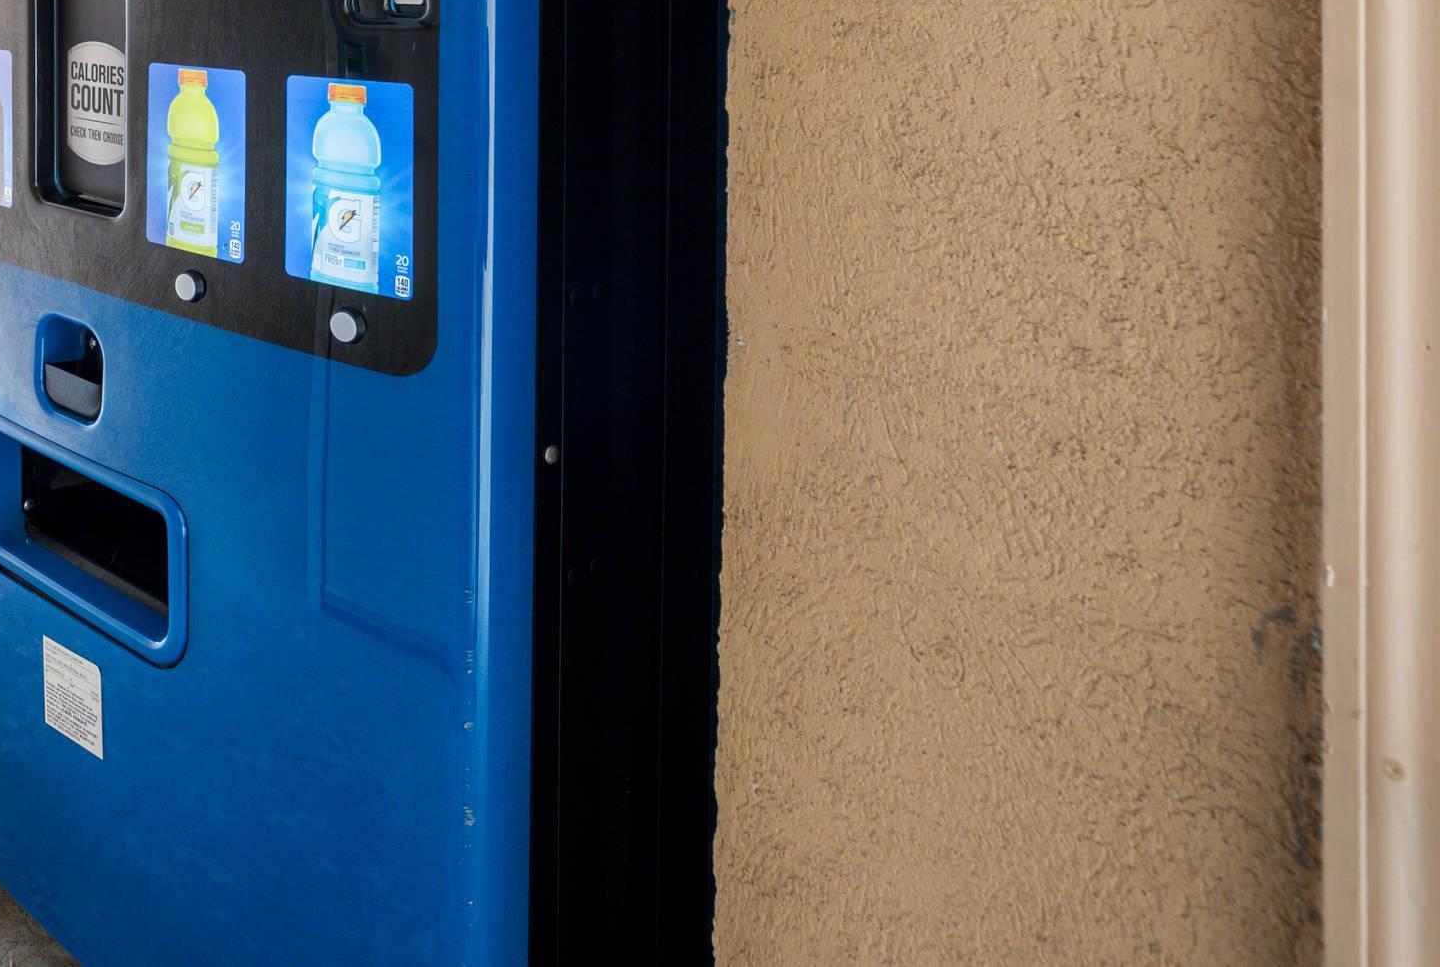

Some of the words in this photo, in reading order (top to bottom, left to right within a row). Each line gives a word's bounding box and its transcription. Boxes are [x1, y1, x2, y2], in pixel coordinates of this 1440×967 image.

[70, 61, 124, 86] CALORIES
[71, 83, 124, 117] COUNT
[70, 125, 86, 138] CHECK
[88, 128, 101, 141] THEN
[102, 131, 124, 146] CHOOSE
[230, 220, 241, 231] 20
[396, 254, 409, 267] 20
[397, 277, 409, 288] 140
